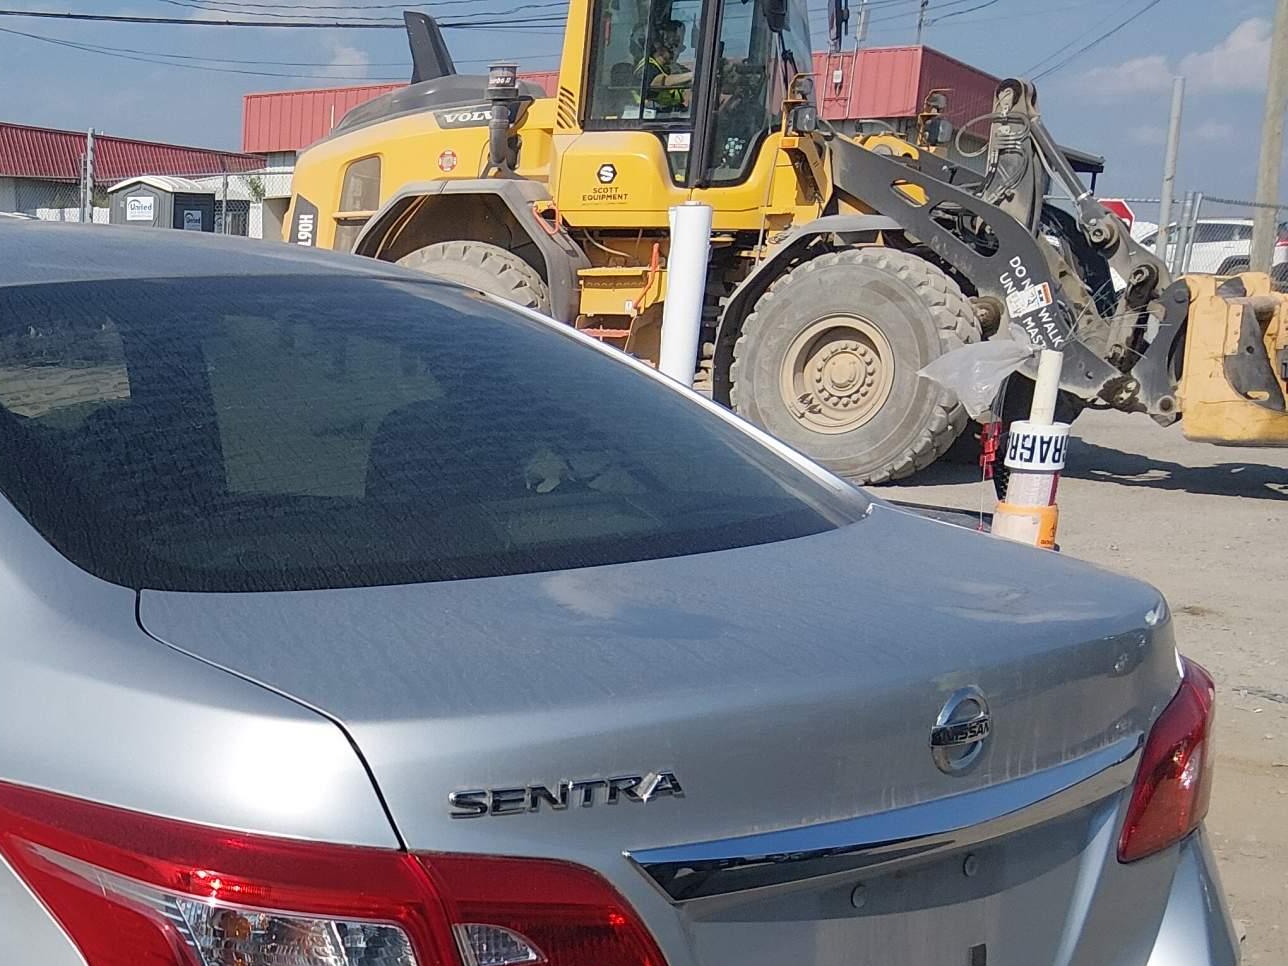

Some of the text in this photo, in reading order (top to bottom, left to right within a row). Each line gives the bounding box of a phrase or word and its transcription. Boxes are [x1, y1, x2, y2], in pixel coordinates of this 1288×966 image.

[1009, 256, 1026, 277] DO
[1038, 307, 1064, 347] WALK
[945, 720, 989, 741] NISSAN
[448, 768, 685, 819] SENTRA
